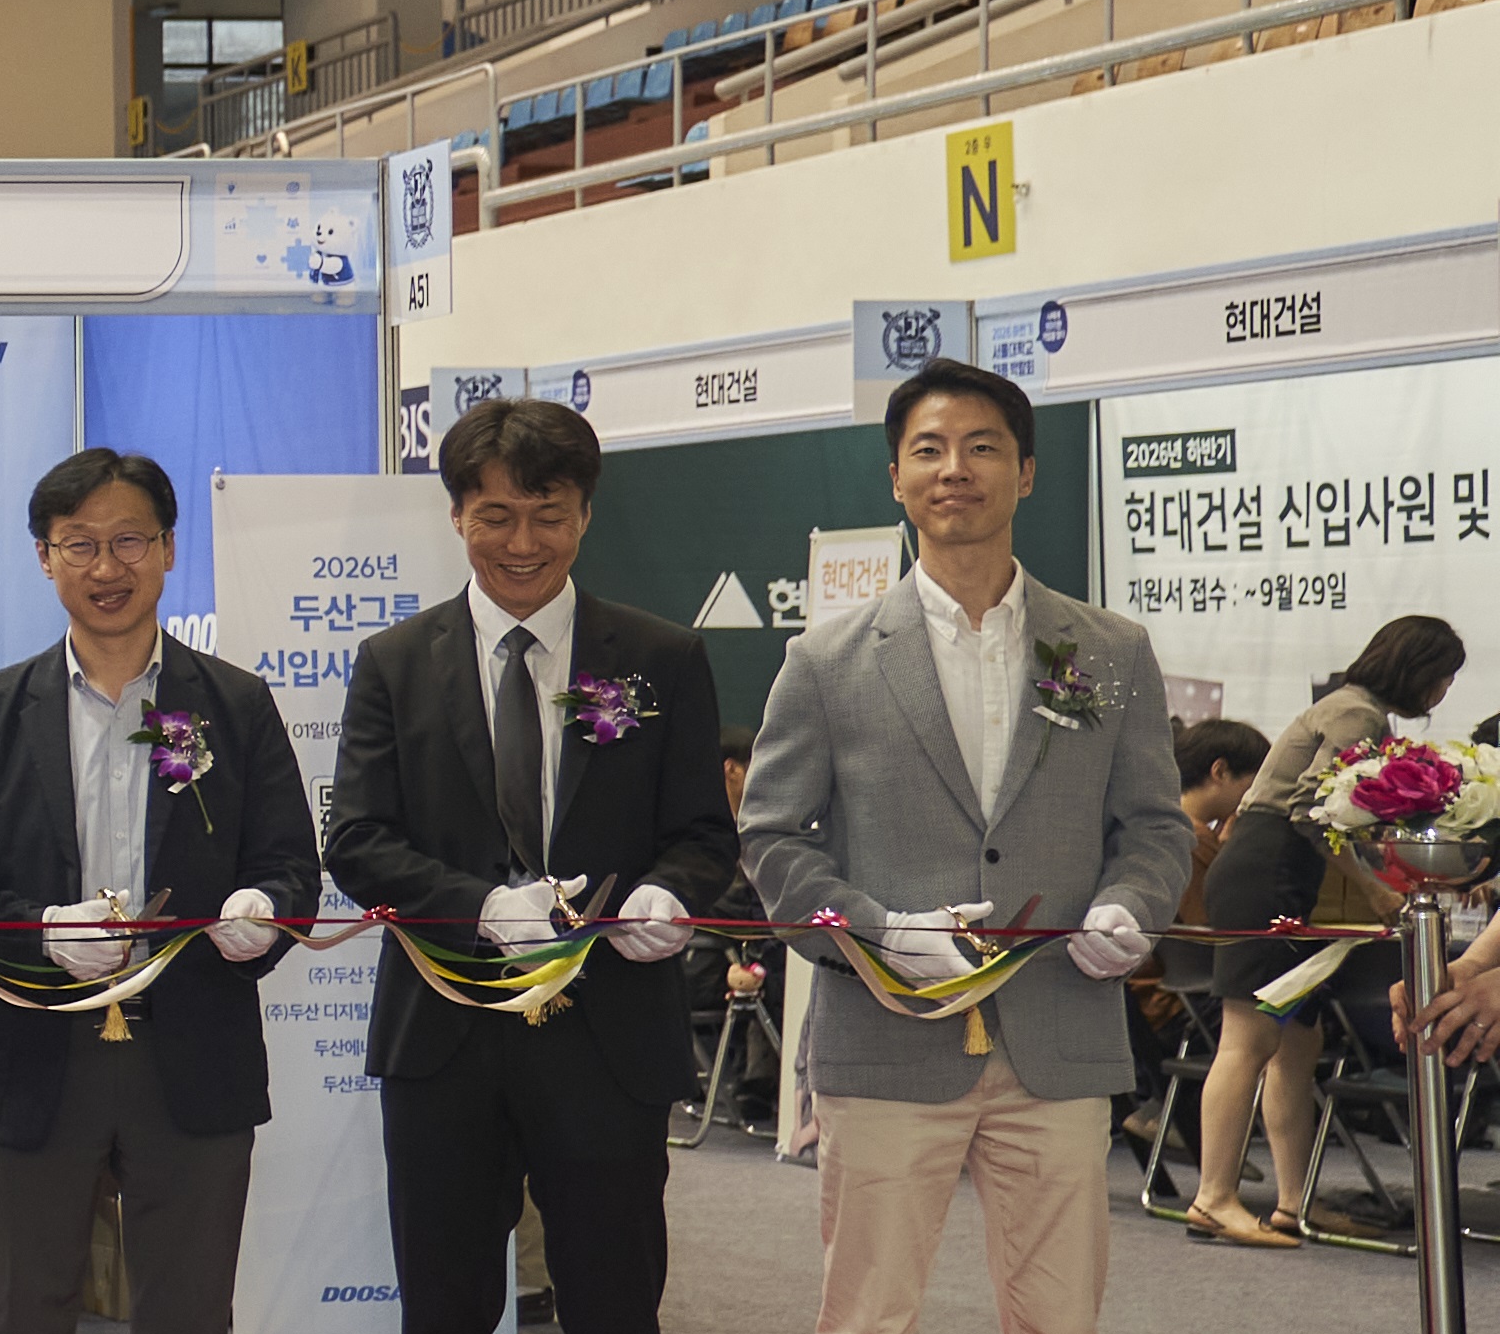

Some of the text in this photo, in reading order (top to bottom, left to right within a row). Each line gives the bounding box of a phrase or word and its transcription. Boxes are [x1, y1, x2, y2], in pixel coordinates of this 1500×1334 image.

[962, 160, 999, 247] N
[409, 273, 428, 310] A51
[1225, 292, 1321, 343] 현대건설
[695, 369, 757, 408] 현대건설
[1127, 436, 1232, 470] 2026년 하반기
[1125, 469, 1489, 554] 현대건설 신입사원 및
[313, 554, 397, 580] 2026년
[821, 556, 890, 600] 현대건설
[1129, 578, 1182, 613] 지원서
[1190, 577, 1226, 612] 접수
[1299, 572, 1346, 609] 29일
[309, 966, 363, 984] (주)두산
[265, 1003, 319, 1021] (주)두산
